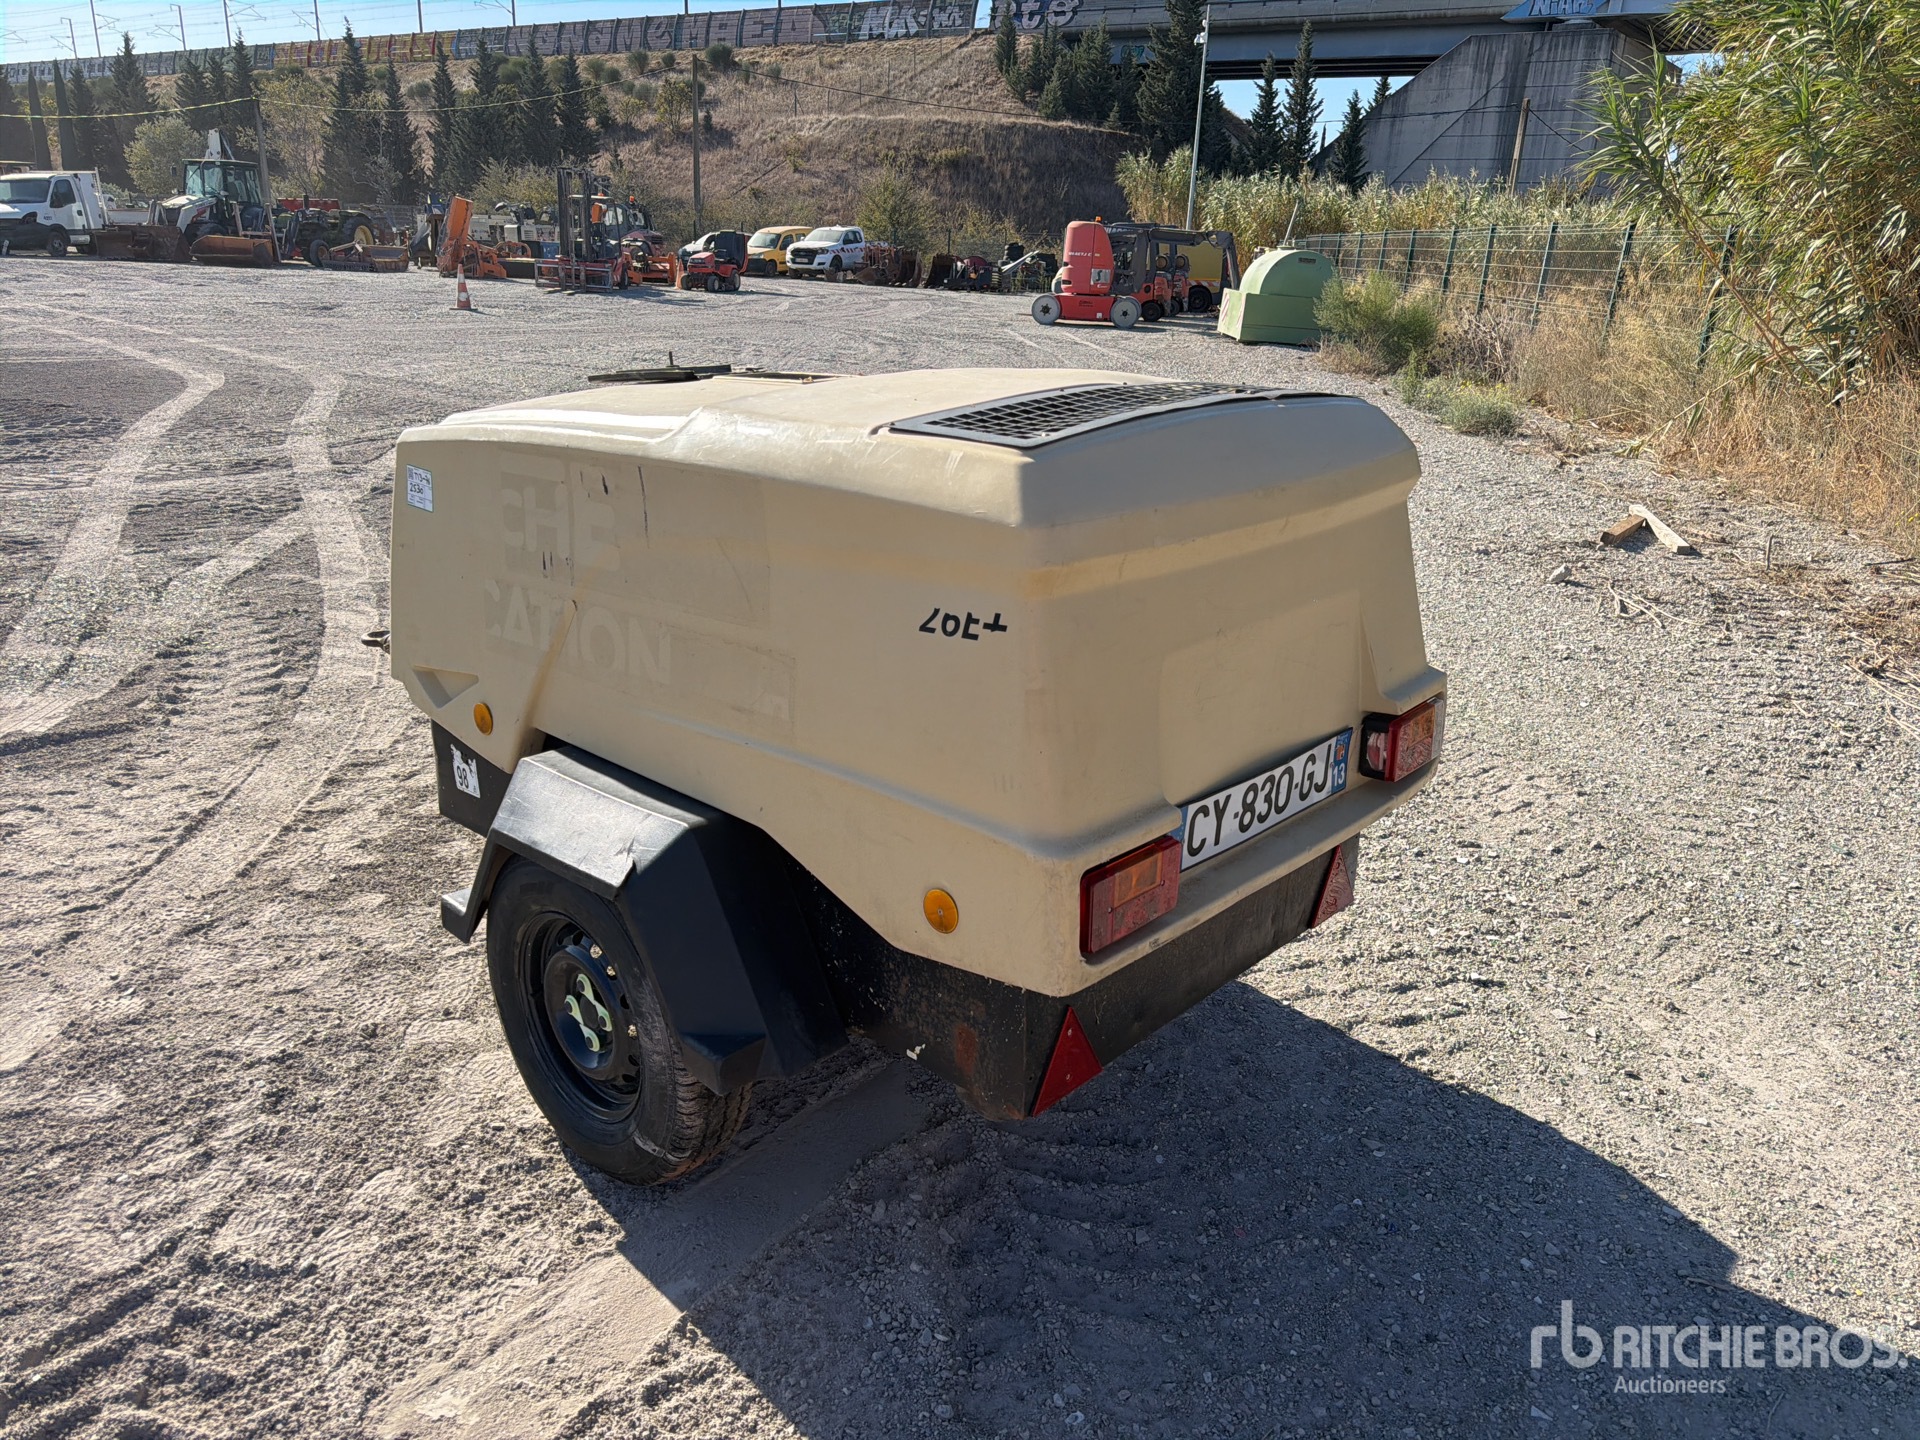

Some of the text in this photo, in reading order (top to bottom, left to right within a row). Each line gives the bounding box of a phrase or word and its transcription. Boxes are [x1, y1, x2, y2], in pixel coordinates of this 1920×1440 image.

[456, 765, 469, 789] 98
[1332, 762, 1346, 787] 13
[1186, 743, 1332, 857] CY-830-GJ
